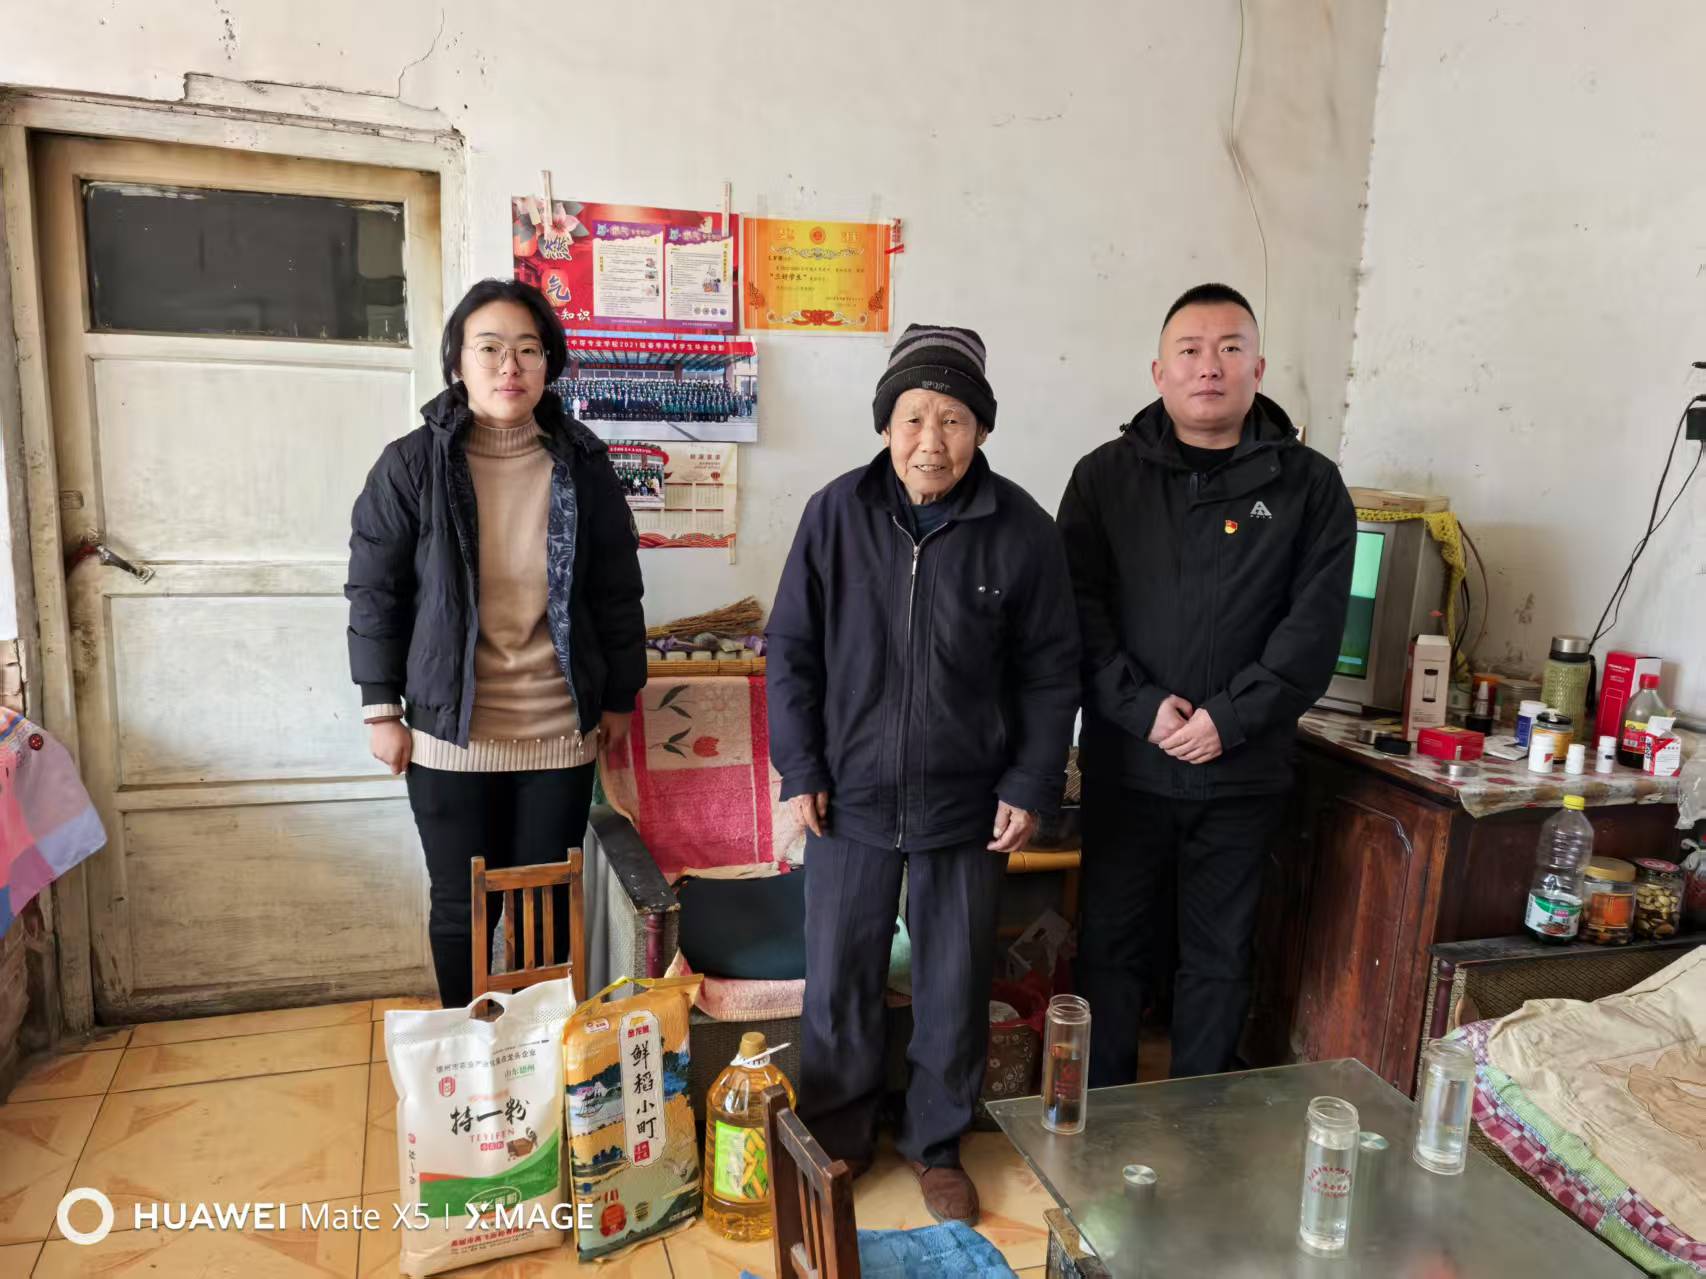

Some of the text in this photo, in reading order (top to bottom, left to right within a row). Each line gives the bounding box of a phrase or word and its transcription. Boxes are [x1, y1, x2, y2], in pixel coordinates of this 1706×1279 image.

[554, 308, 591, 321] 知识
[630, 1040, 657, 1140] 鲜稻小町
[450, 1096, 528, 1136] 特一粉
